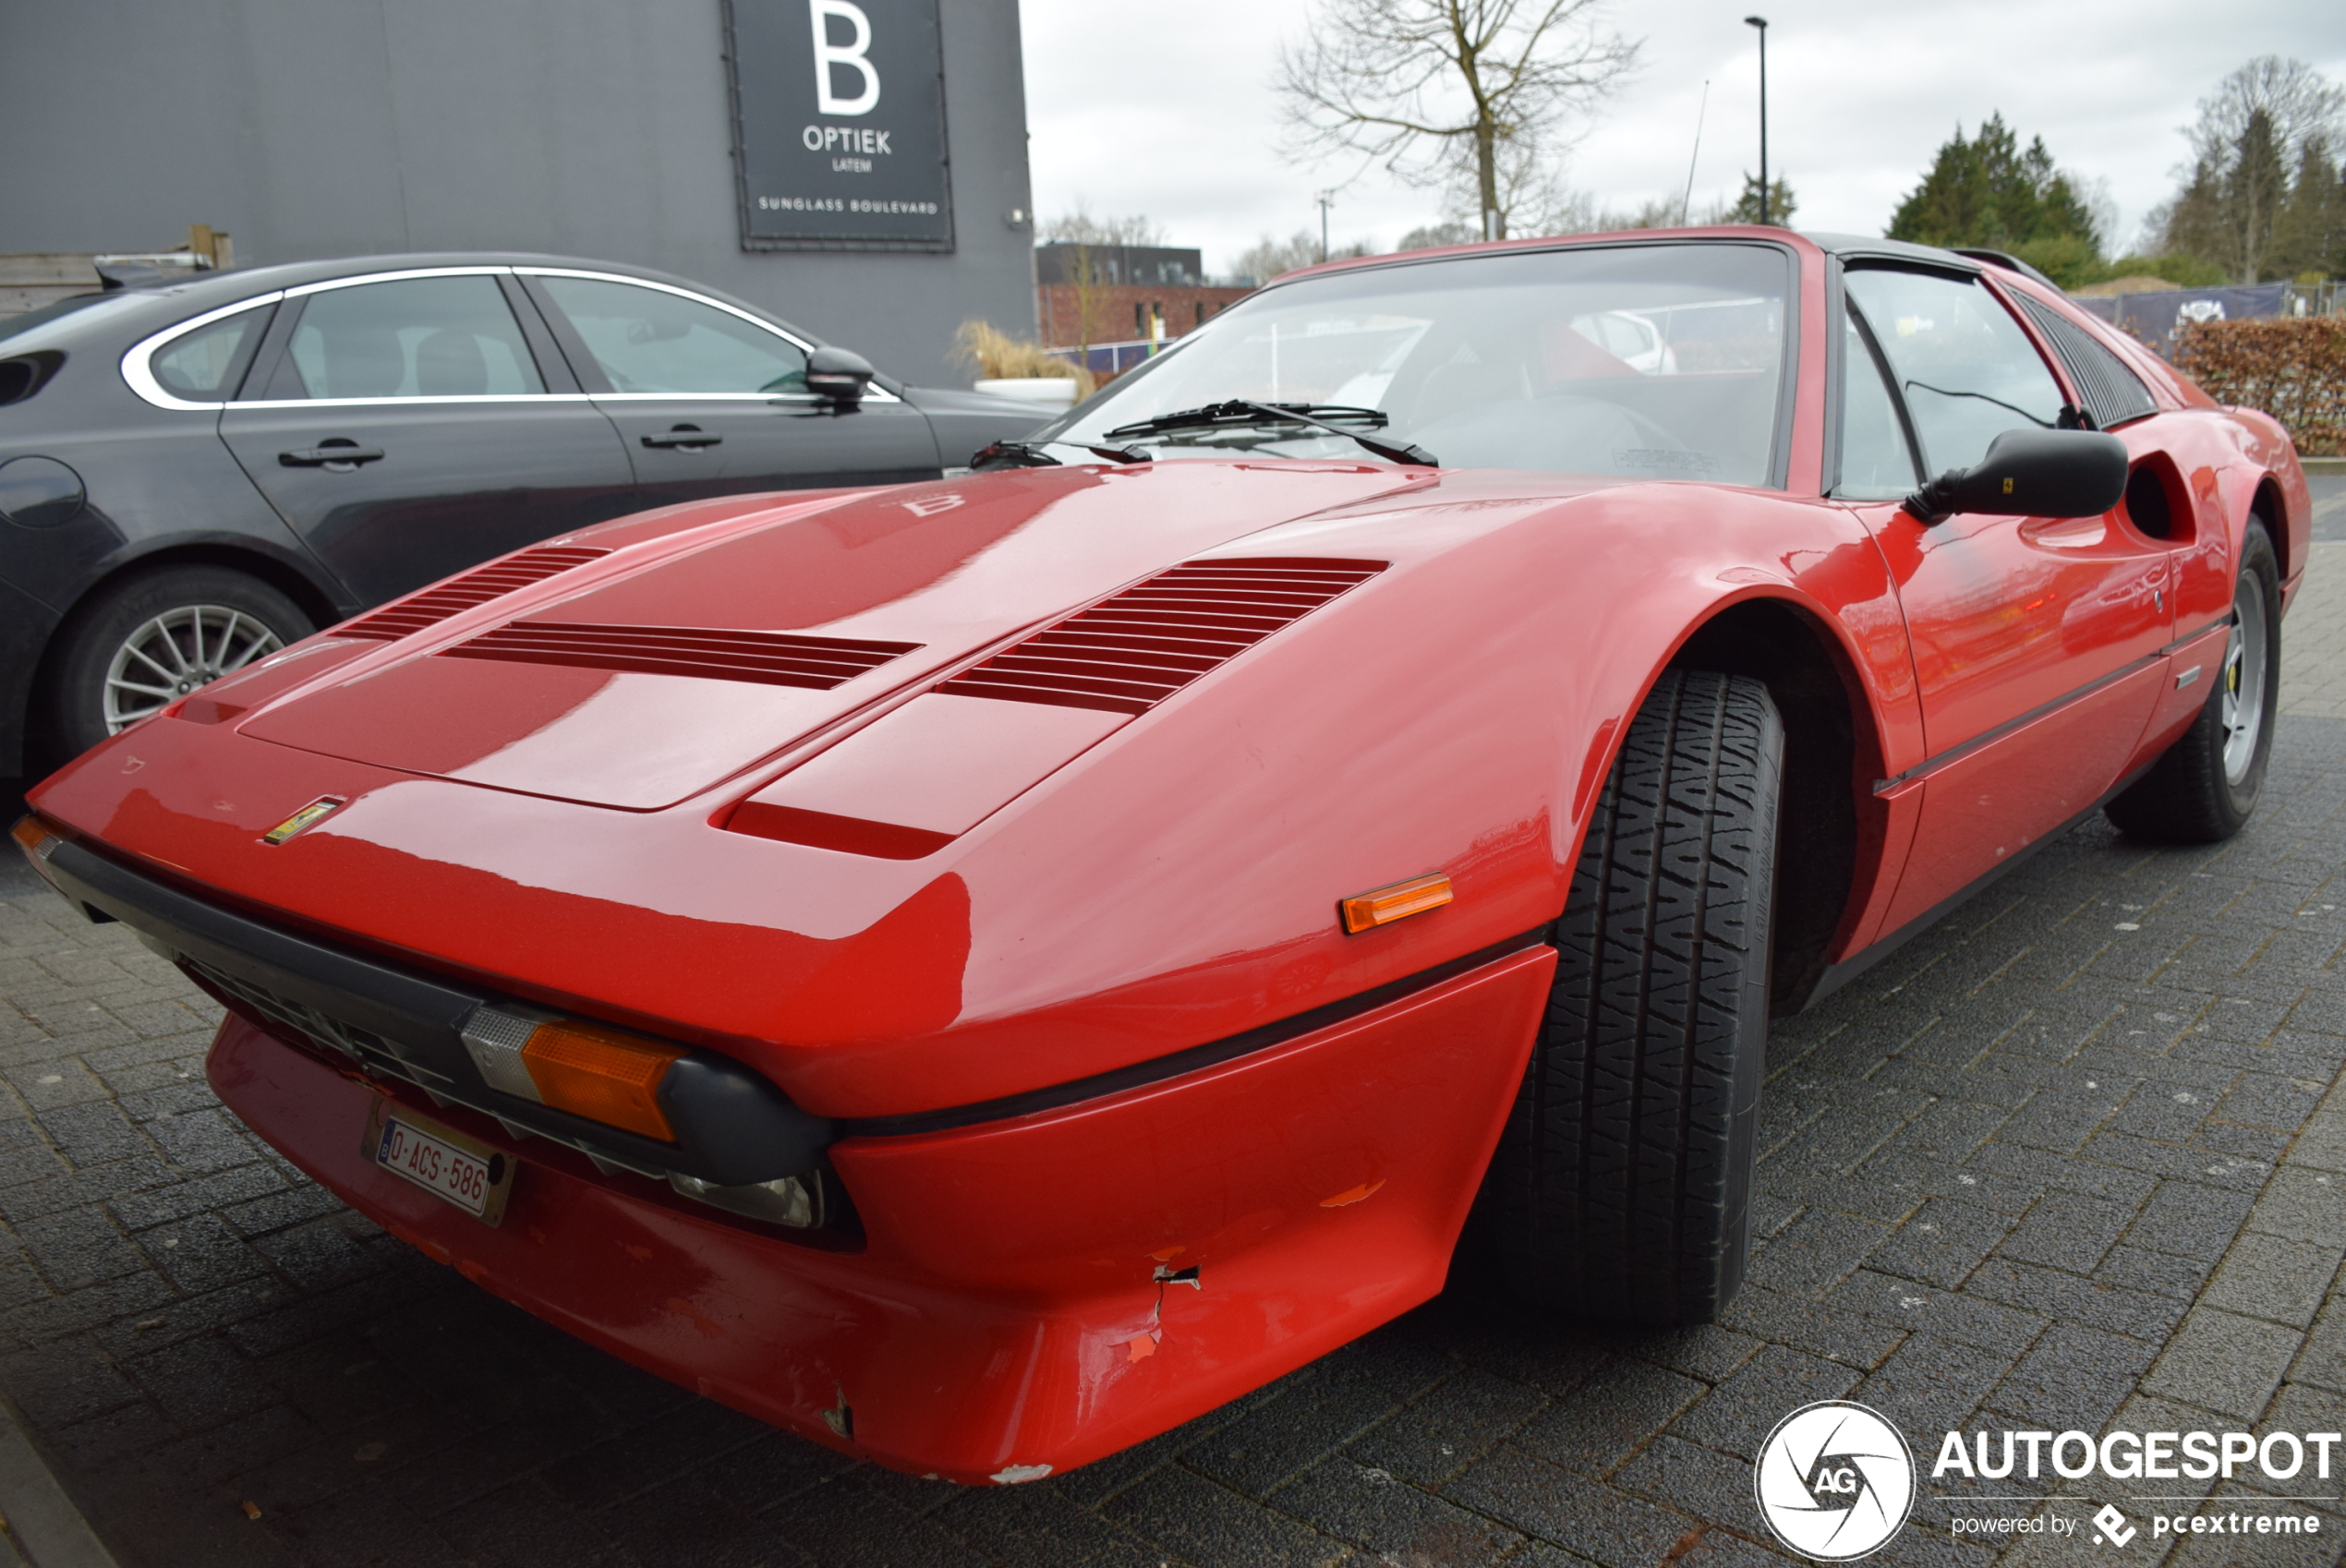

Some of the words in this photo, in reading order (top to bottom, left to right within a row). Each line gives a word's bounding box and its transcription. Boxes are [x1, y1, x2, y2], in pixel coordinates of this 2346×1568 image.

[809, 0, 880, 115] B
[802, 125, 892, 155] OPTIEK
[832, 158, 873, 174] LATEM
[758, 196, 844, 212] SUNGLASS
[850, 199, 937, 215] BOULEVARD
[381, 1144, 390, 1158] B
